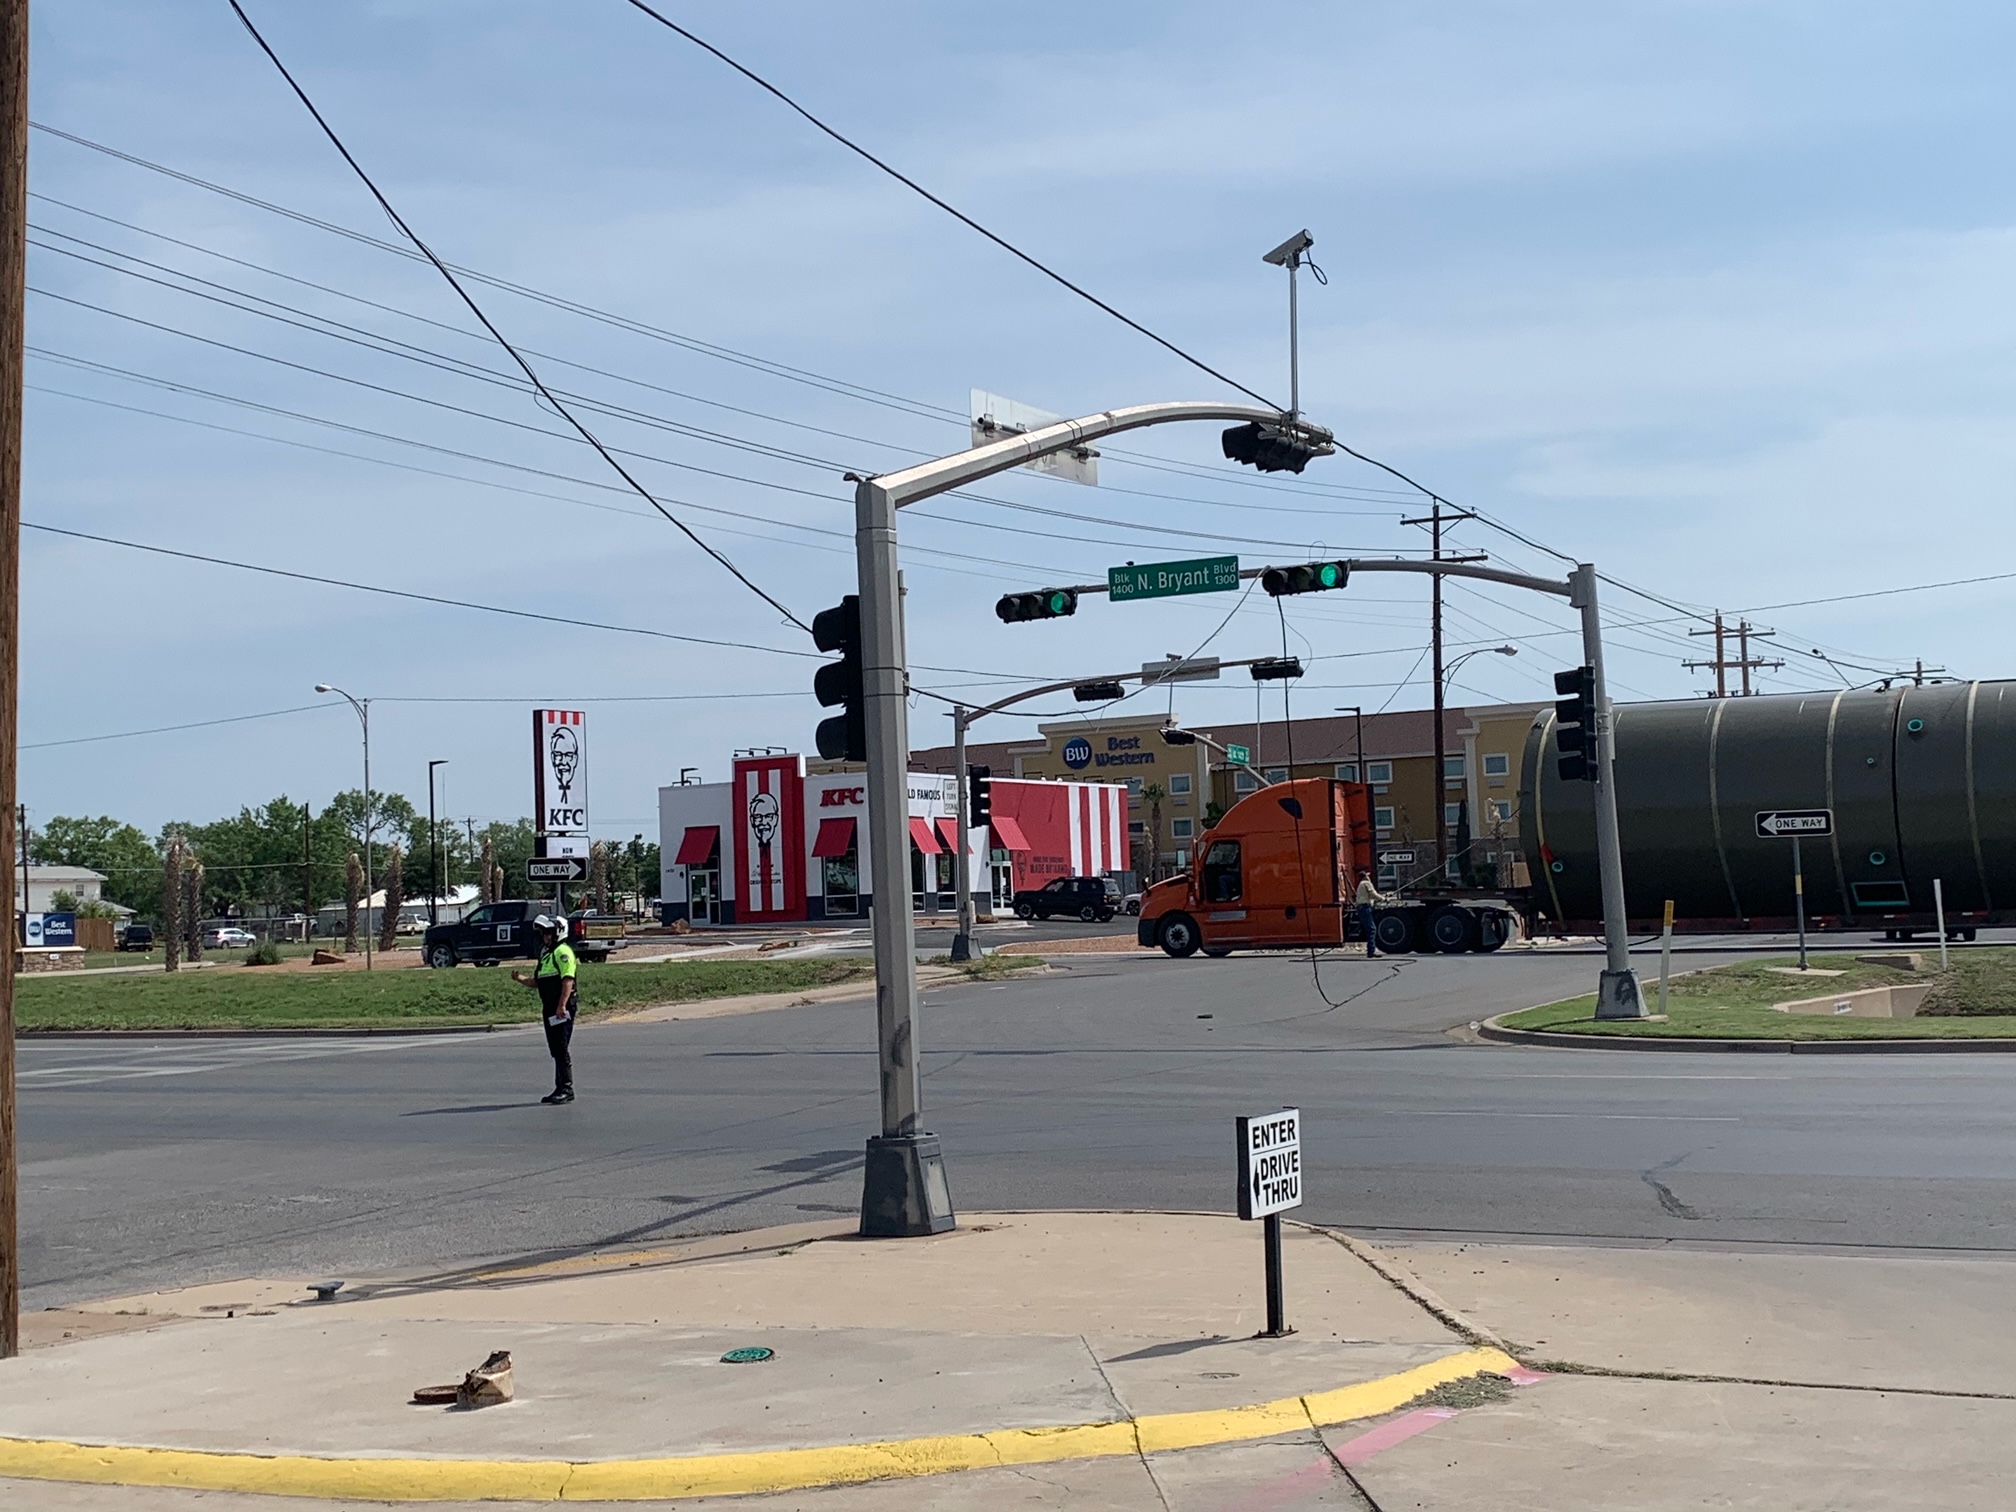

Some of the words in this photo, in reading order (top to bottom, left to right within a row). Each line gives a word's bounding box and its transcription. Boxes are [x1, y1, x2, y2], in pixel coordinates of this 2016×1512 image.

[1213, 562, 1237, 575] Blvd
[1114, 573, 1130, 584] Blk
[1137, 573, 1153, 591] N.
[1158, 567, 1210, 592] Bryant
[1214, 574, 1237, 585] 1300
[1112, 584, 1134, 595] 1400
[1107, 736, 1141, 751] Best
[1066, 748, 1089, 762] BW
[1095, 752, 1155, 767] Western
[820, 787, 864, 807] KFC
[917, 789, 941, 800] FAMOUS
[548, 808, 584, 826] KFC
[1775, 819, 1797, 828] ONE
[1800, 818, 1823, 827] WAY
[533, 865, 550, 875] ONE
[553, 865, 571, 874] WAY
[1252, 1118, 1296, 1149] ENTER
[1260, 1150, 1299, 1181] DRIVE
[1263, 1176, 1298, 1206] THRU
